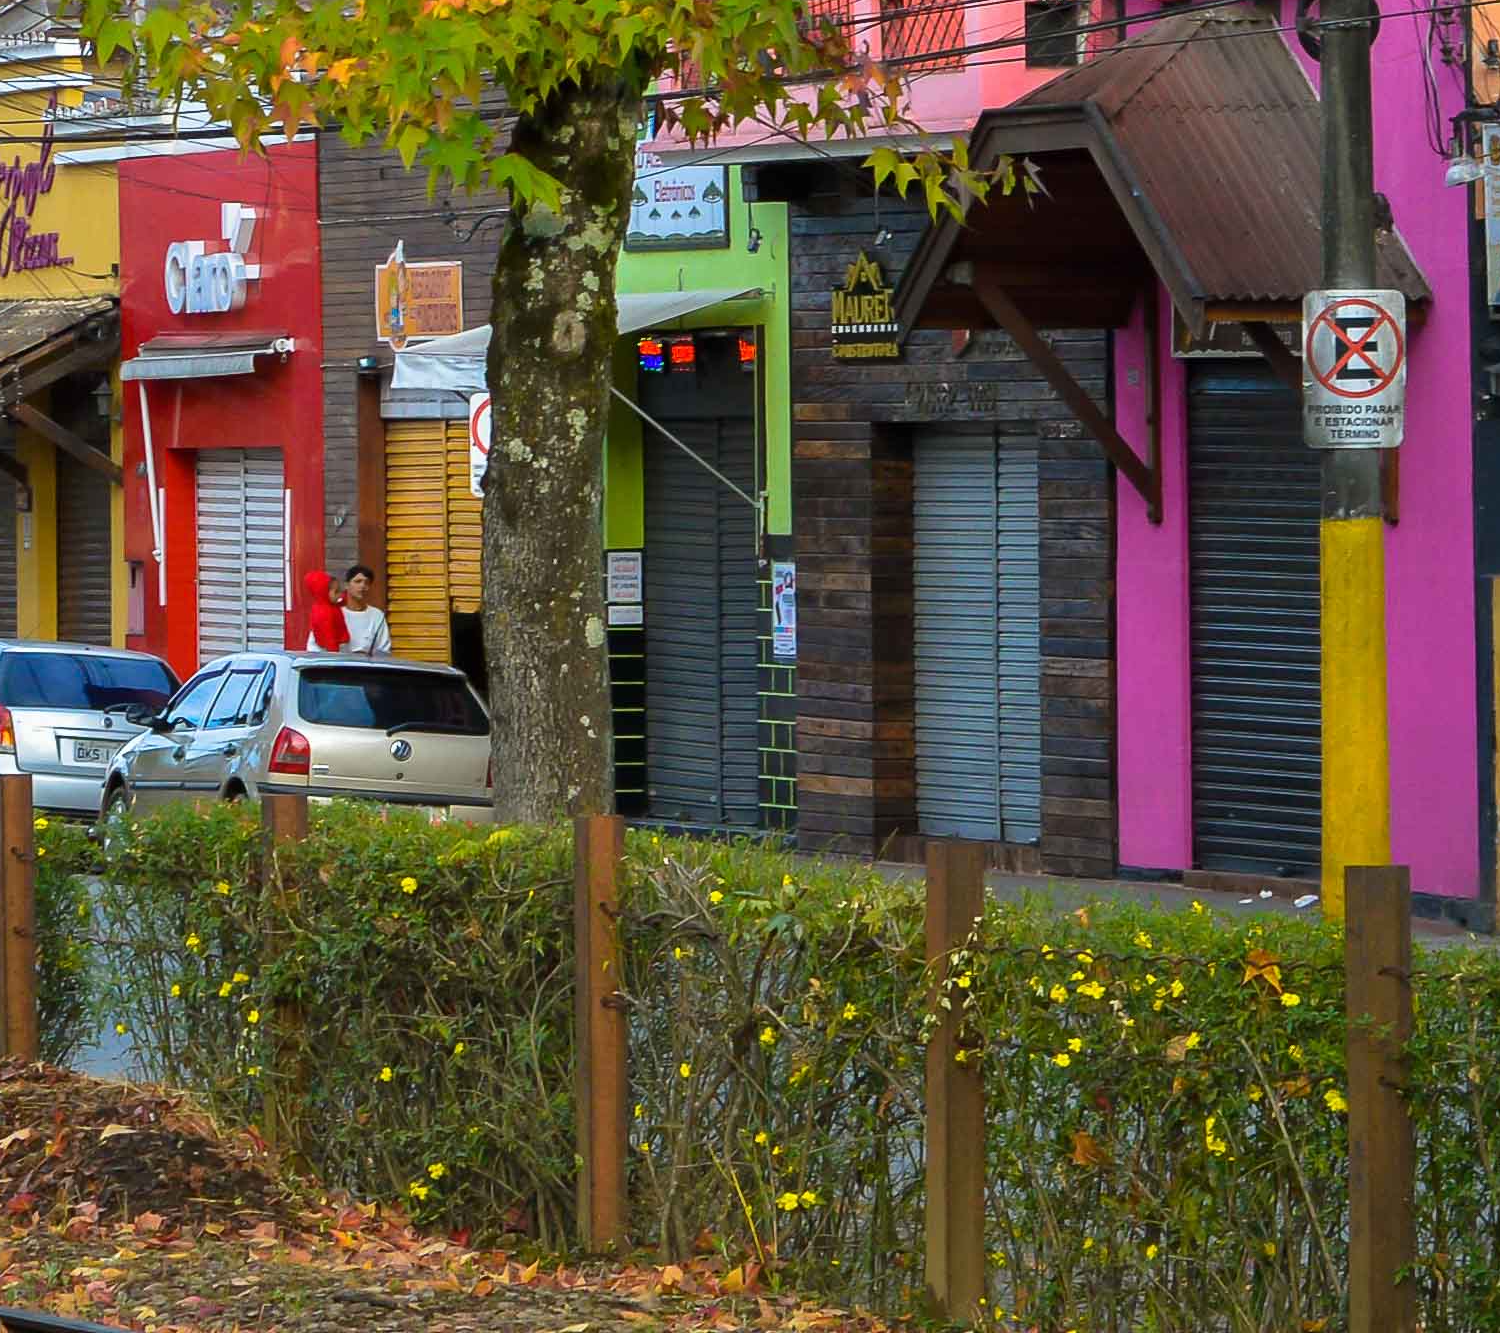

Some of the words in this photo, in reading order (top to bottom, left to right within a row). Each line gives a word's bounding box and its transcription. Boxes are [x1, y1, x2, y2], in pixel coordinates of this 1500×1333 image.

[164, 239, 246, 315] Claro
[1308, 404, 1362, 415] PROIBIDO
[1365, 403, 1401, 415] PARAR
[1314, 417, 1322, 427] E
[1324, 416, 1395, 427] ESTACIONAR
